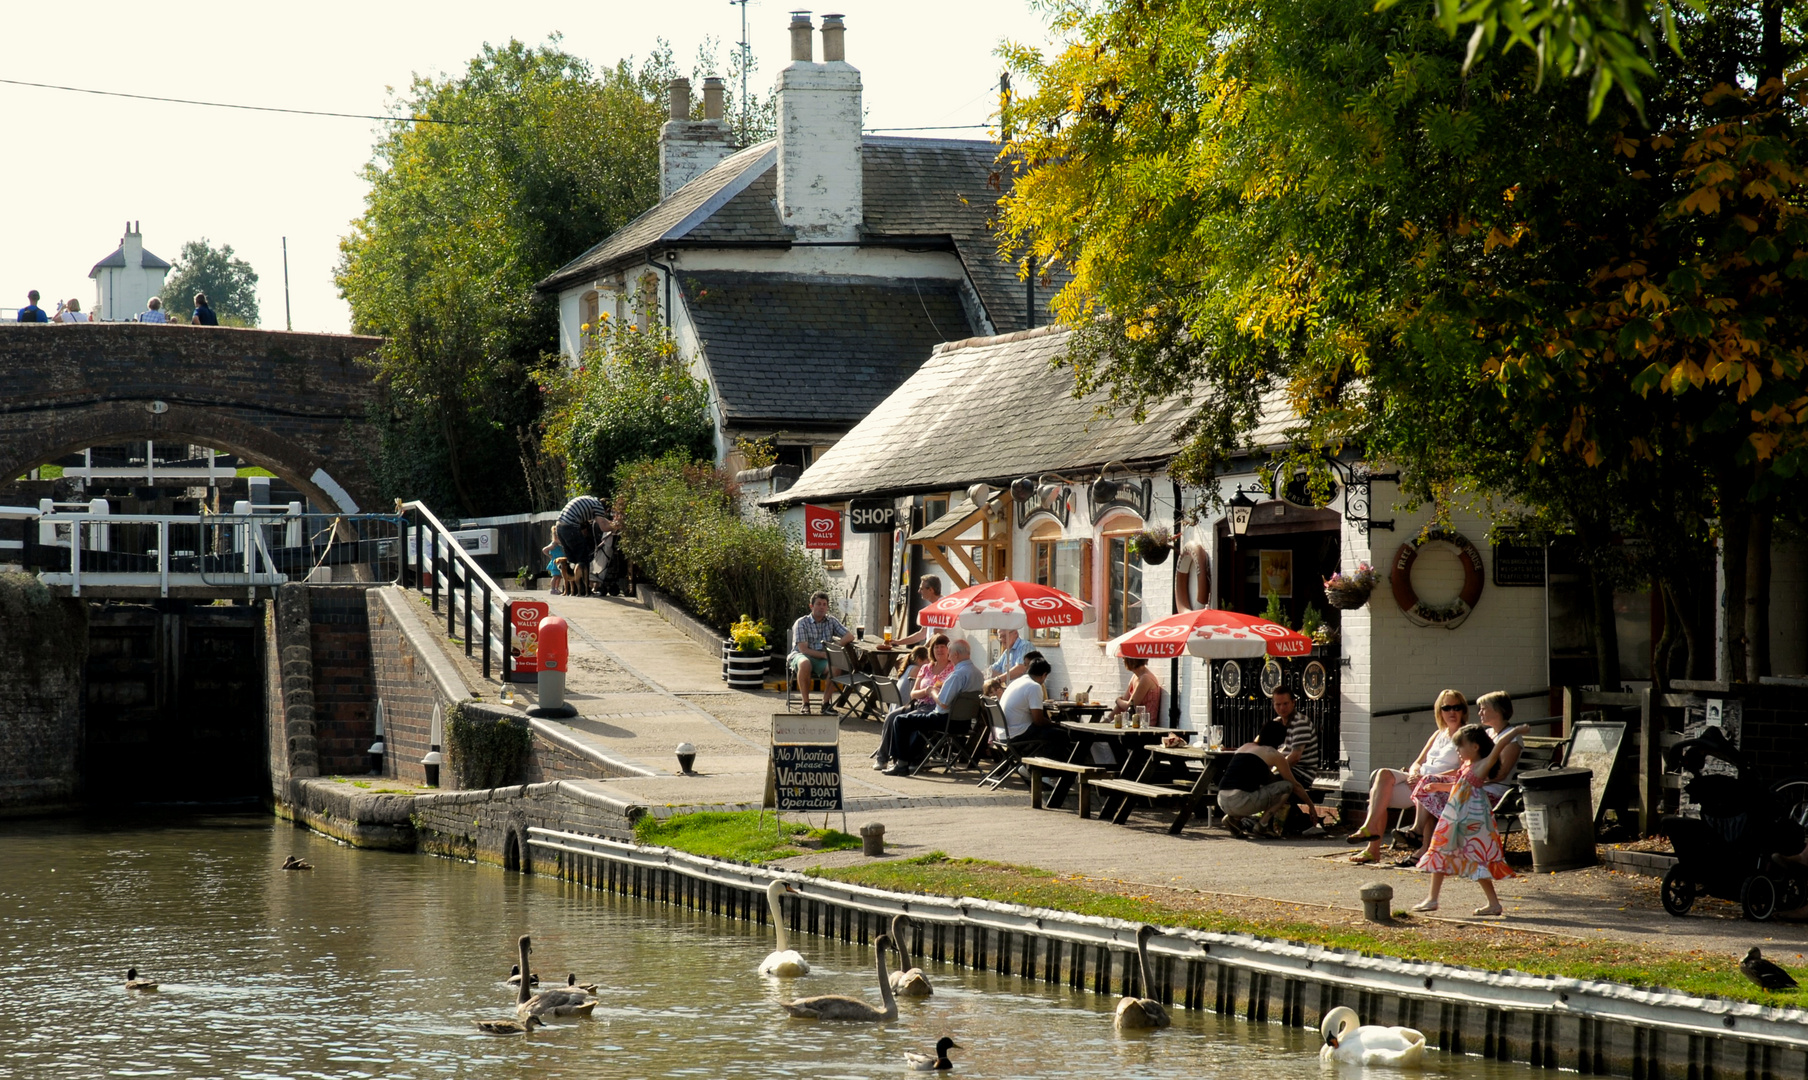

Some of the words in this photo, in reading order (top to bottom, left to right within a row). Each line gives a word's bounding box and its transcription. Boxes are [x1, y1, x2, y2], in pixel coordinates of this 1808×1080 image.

[852, 508, 894, 524] SHOP
[1236, 515, 1246, 523] 61
[1397, 548, 1412, 570] FREE
[1465, 546, 1483, 573] HOUSE
[1038, 614, 1072, 626] WALL'S
[1136, 643, 1175, 655] WALL'S
[1275, 640, 1304, 653] WALL'S
[776, 748, 791, 761] No
[792, 747, 834, 764] Mooring
[795, 761, 823, 771] please
[777, 766, 840, 786] VAGABOND
[810, 787, 838, 797] BOAT
[781, 797, 838, 809] Operating
